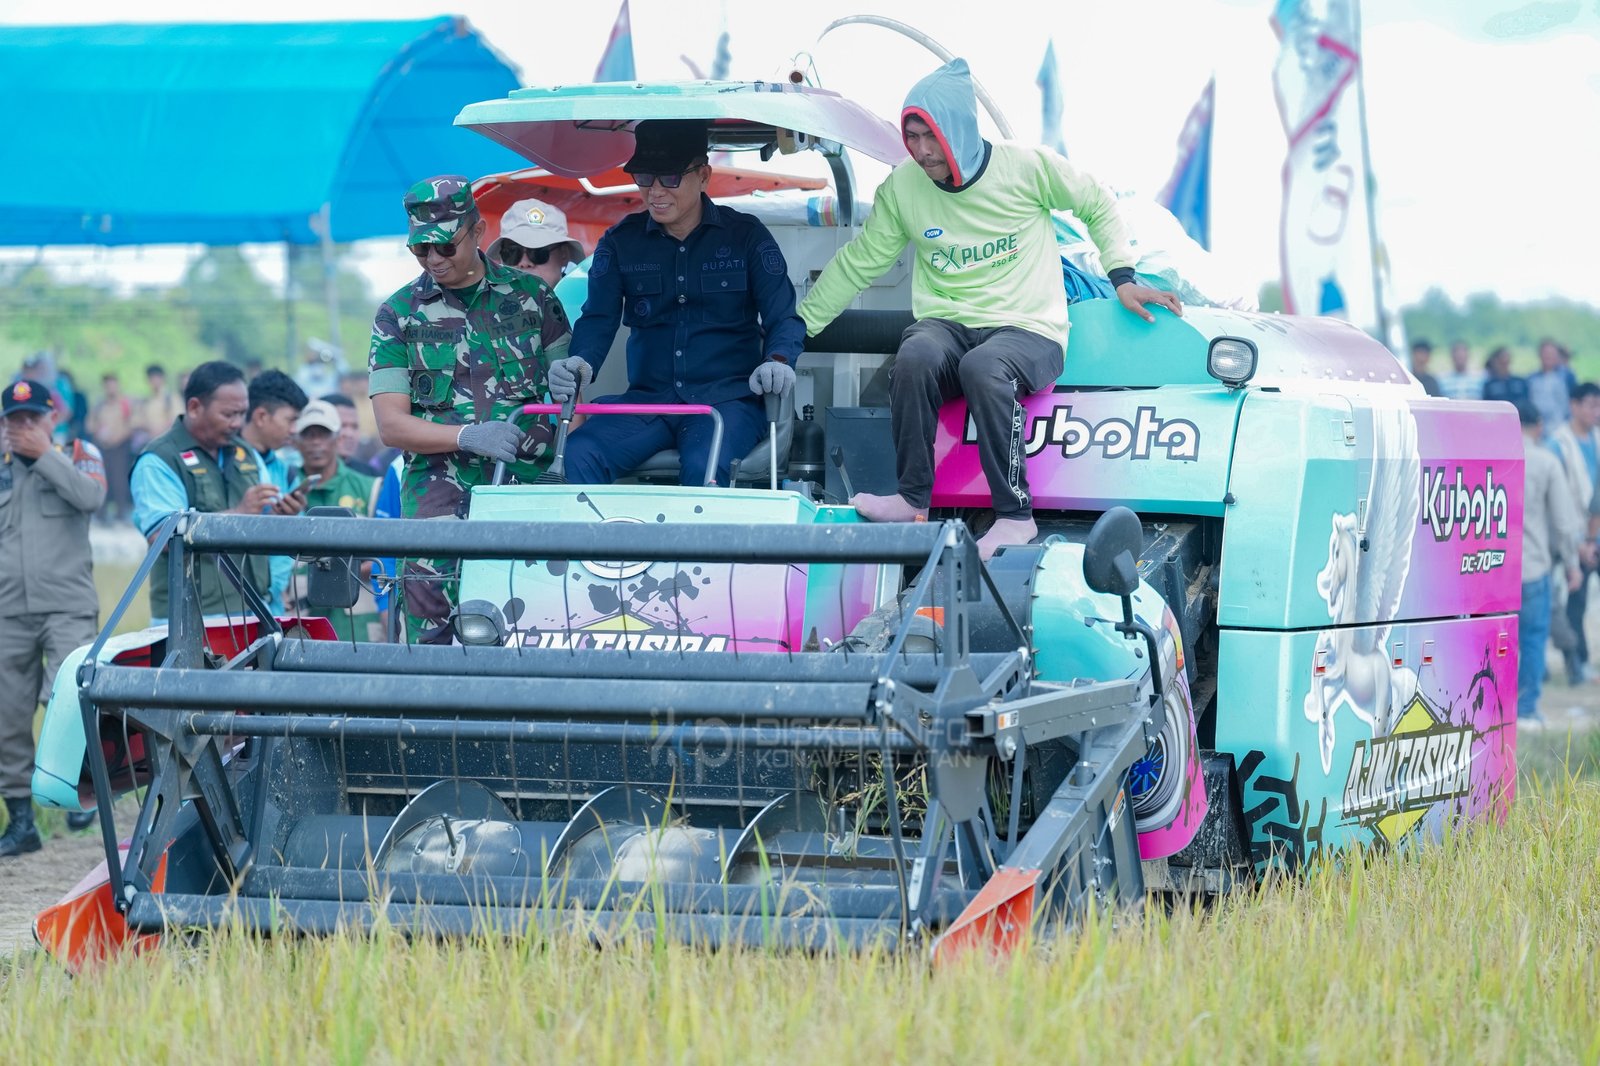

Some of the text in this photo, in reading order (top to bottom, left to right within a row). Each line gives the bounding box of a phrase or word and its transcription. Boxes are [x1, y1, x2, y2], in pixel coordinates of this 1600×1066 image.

[930, 233, 1018, 273] EXPLORE
[991, 252, 1018, 268] 250 EC
[702, 260, 745, 271] BUPATI
[495, 316, 537, 334] TNI AD
[1422, 466, 1508, 542] Kubota
[1460, 550, 1492, 575] DC-70
